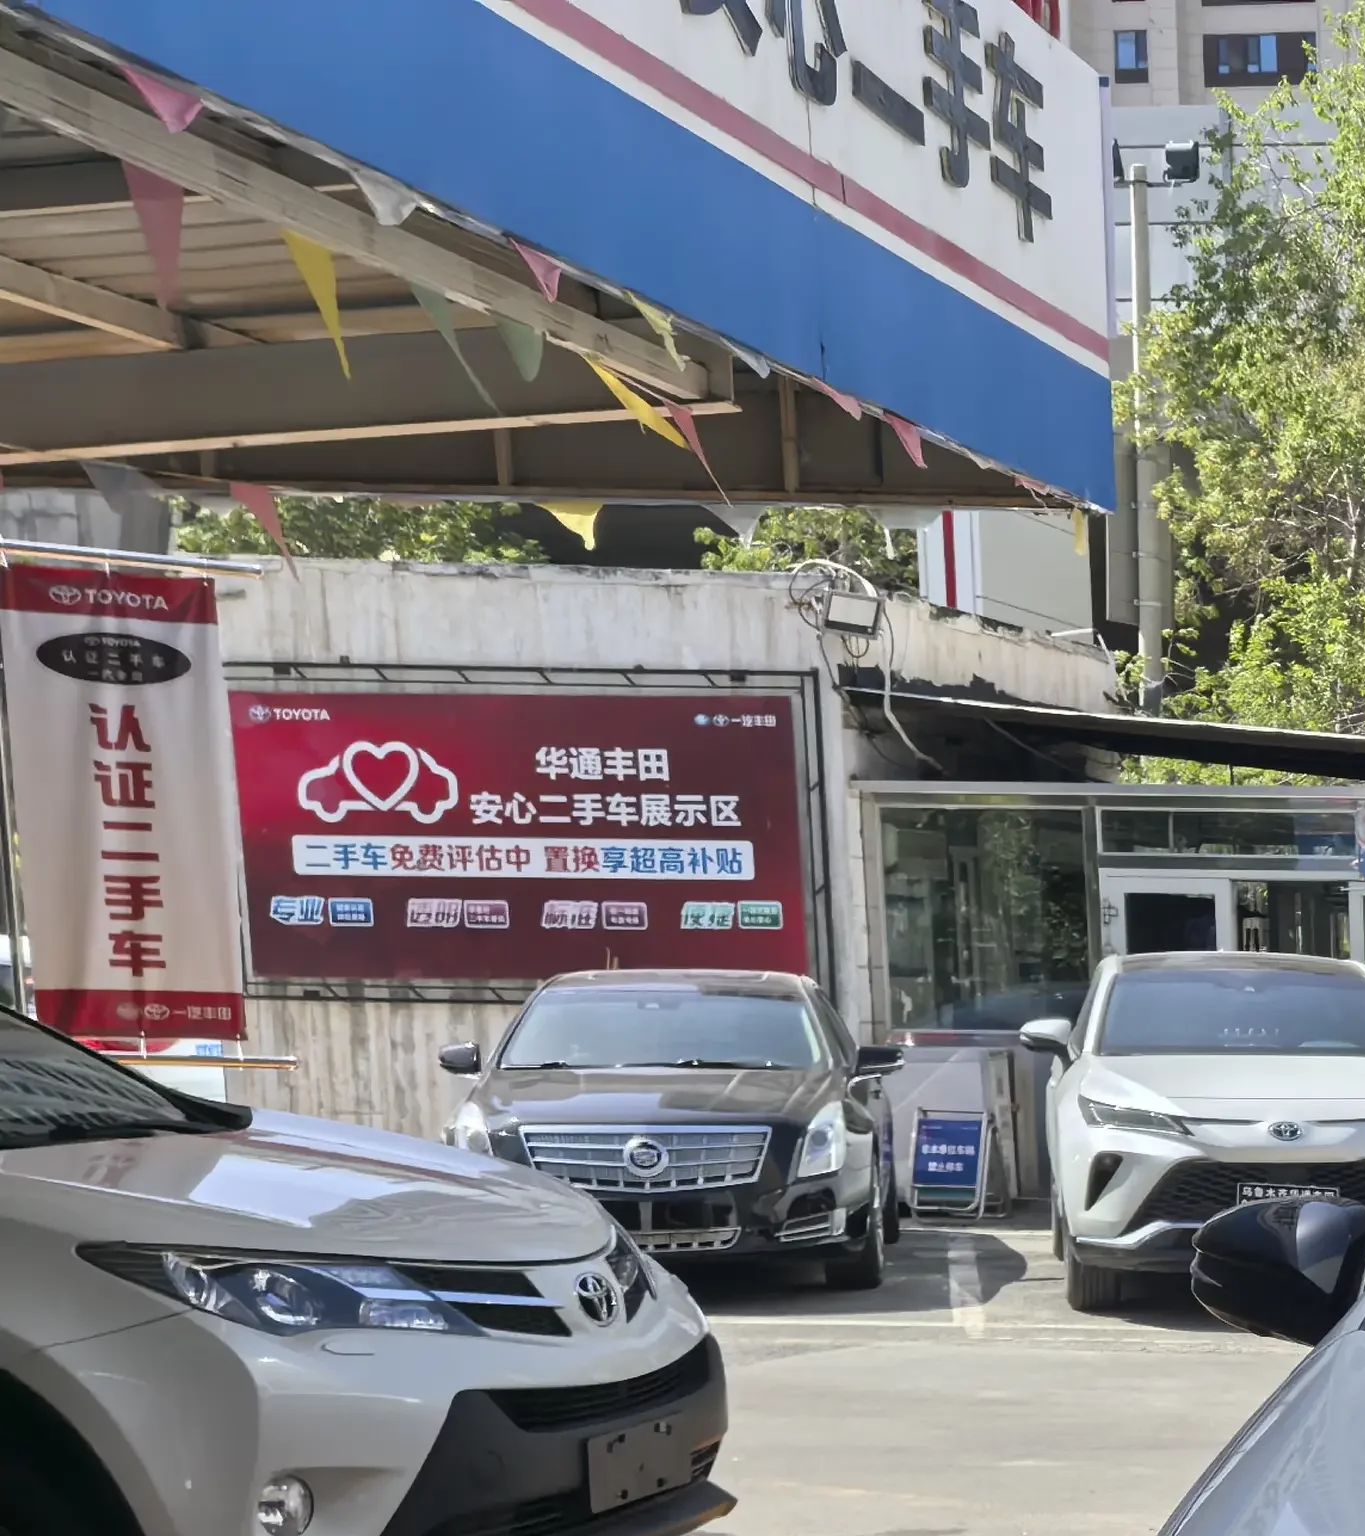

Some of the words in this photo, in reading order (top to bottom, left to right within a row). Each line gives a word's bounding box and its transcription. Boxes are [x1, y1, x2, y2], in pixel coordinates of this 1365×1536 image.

[85, 588, 168, 611] TOYOTA
[101, 636, 141, 648] TOYOTA
[273, 708, 330, 721] TOYOTA
[535, 746, 670, 781] 华通丰田
[470, 791, 742, 827] 安心二手车展示区
[88, 703, 167, 977] 认证二手车
[305, 842, 531, 872] 二手车免费评估中
[543, 845, 743, 875] 置换享超高补贴
